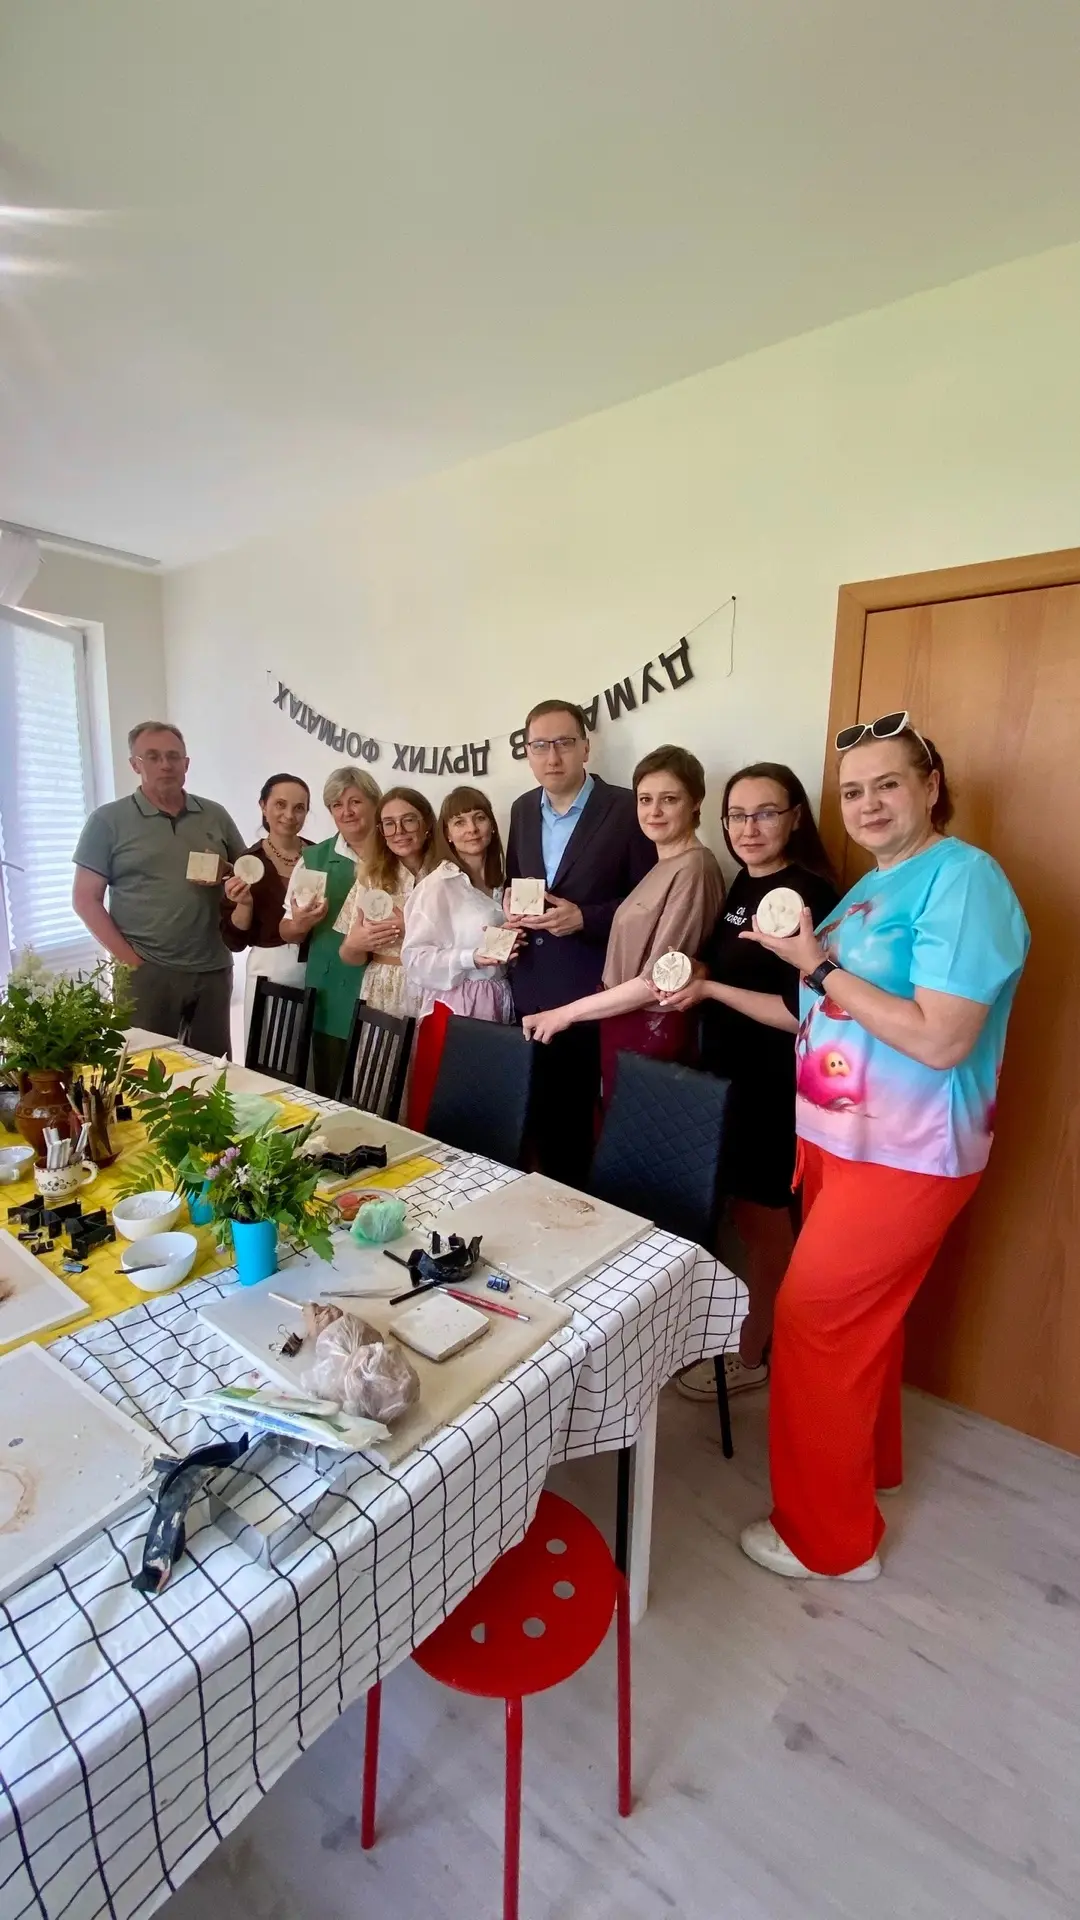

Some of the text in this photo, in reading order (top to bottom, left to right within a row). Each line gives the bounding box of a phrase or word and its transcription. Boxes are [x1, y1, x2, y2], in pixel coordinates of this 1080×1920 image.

[272, 637, 694, 777] ДУМА В ДРУГИХ ФОРМАТАХ
